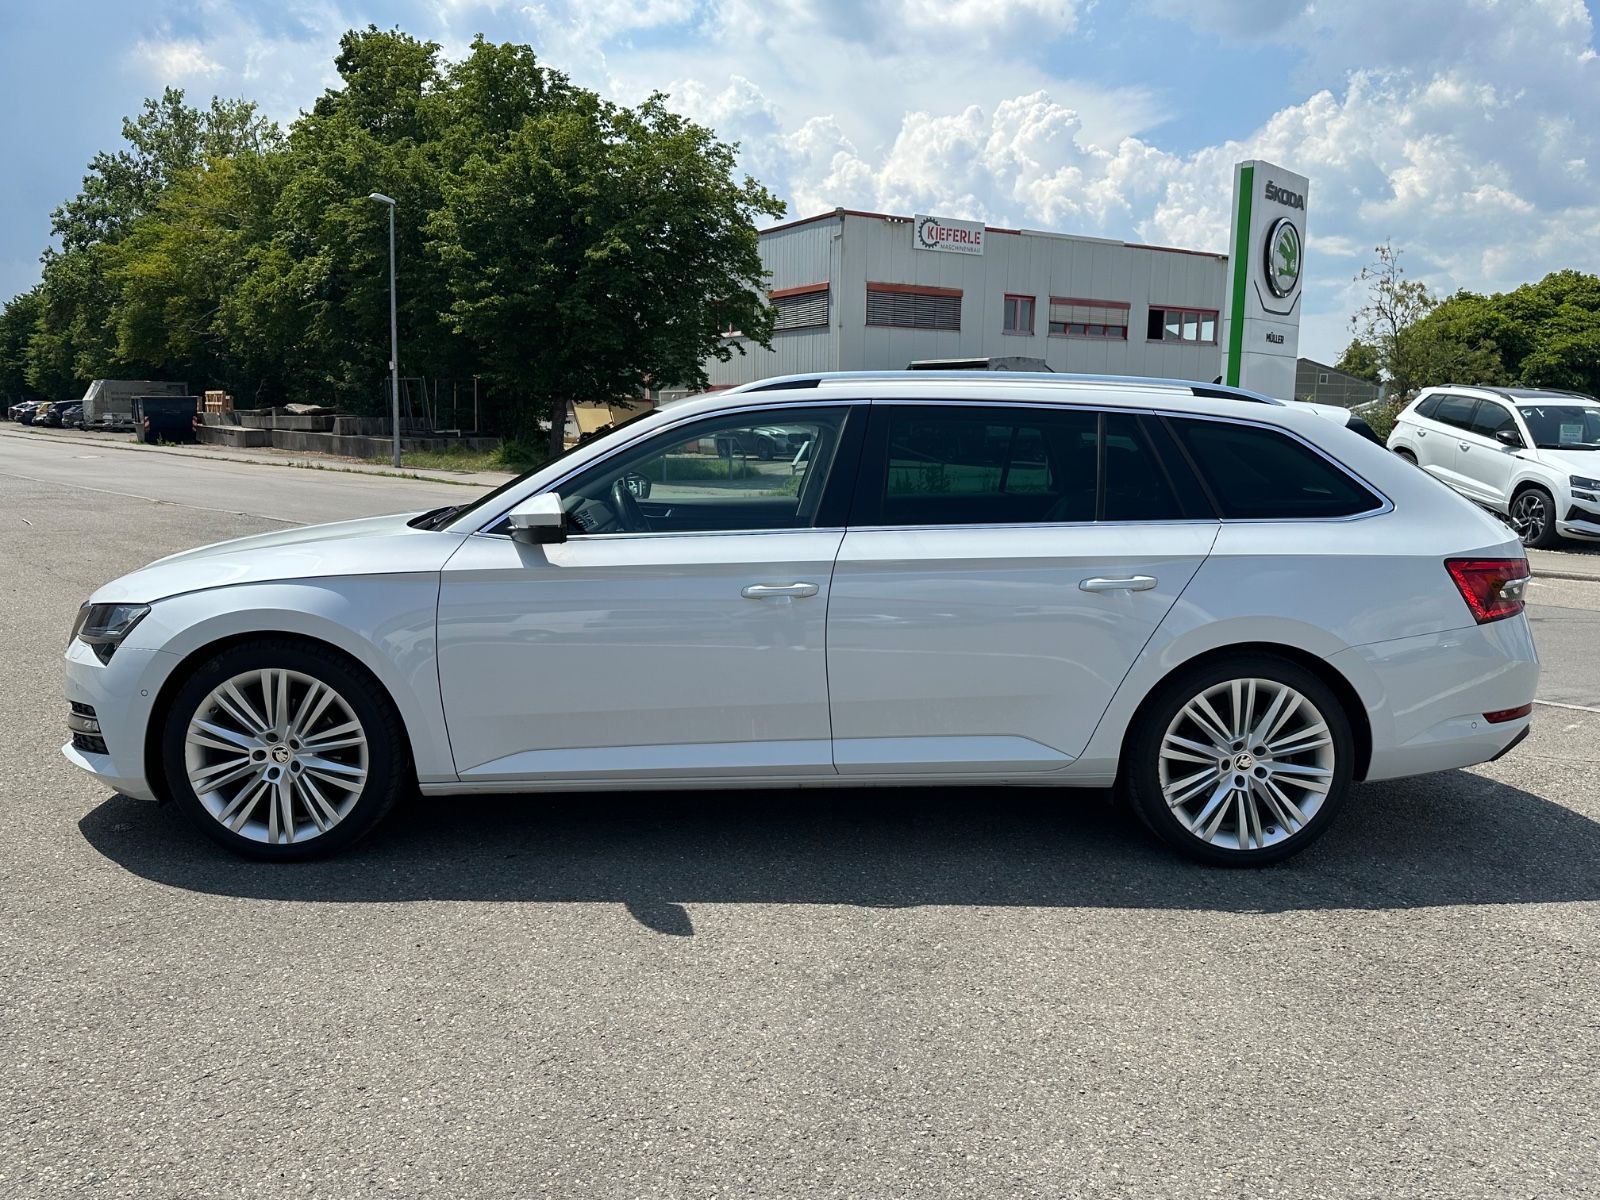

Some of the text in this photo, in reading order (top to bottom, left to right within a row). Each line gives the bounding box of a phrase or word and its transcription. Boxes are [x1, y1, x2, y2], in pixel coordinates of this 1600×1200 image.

[1265, 180, 1304, 211] ŠKODA
[927, 226, 981, 245] KIEFERLE
[1265, 331, 1285, 344] MÜLLER
